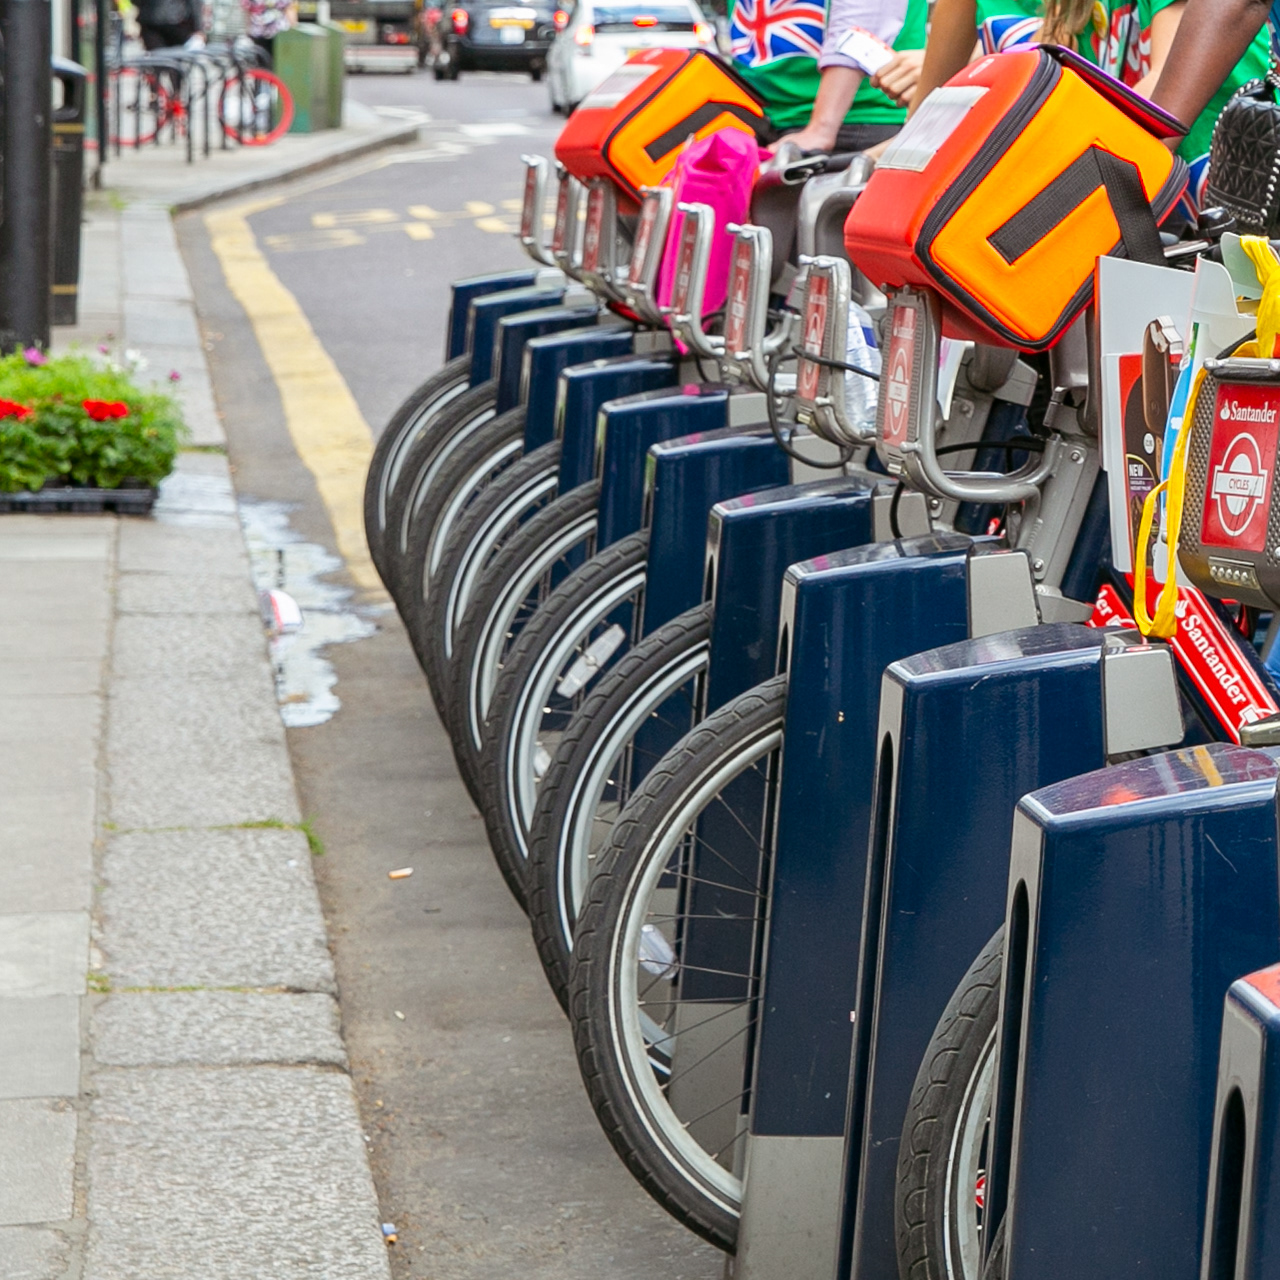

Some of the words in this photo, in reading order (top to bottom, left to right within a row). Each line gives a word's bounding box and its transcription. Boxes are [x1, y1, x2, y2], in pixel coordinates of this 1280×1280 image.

[1230, 400, 1277, 424] Santander
[1129, 464, 1144, 477] NEW
[1228, 477, 1250, 491] CYCLES
[1181, 614, 1247, 705] Santander
